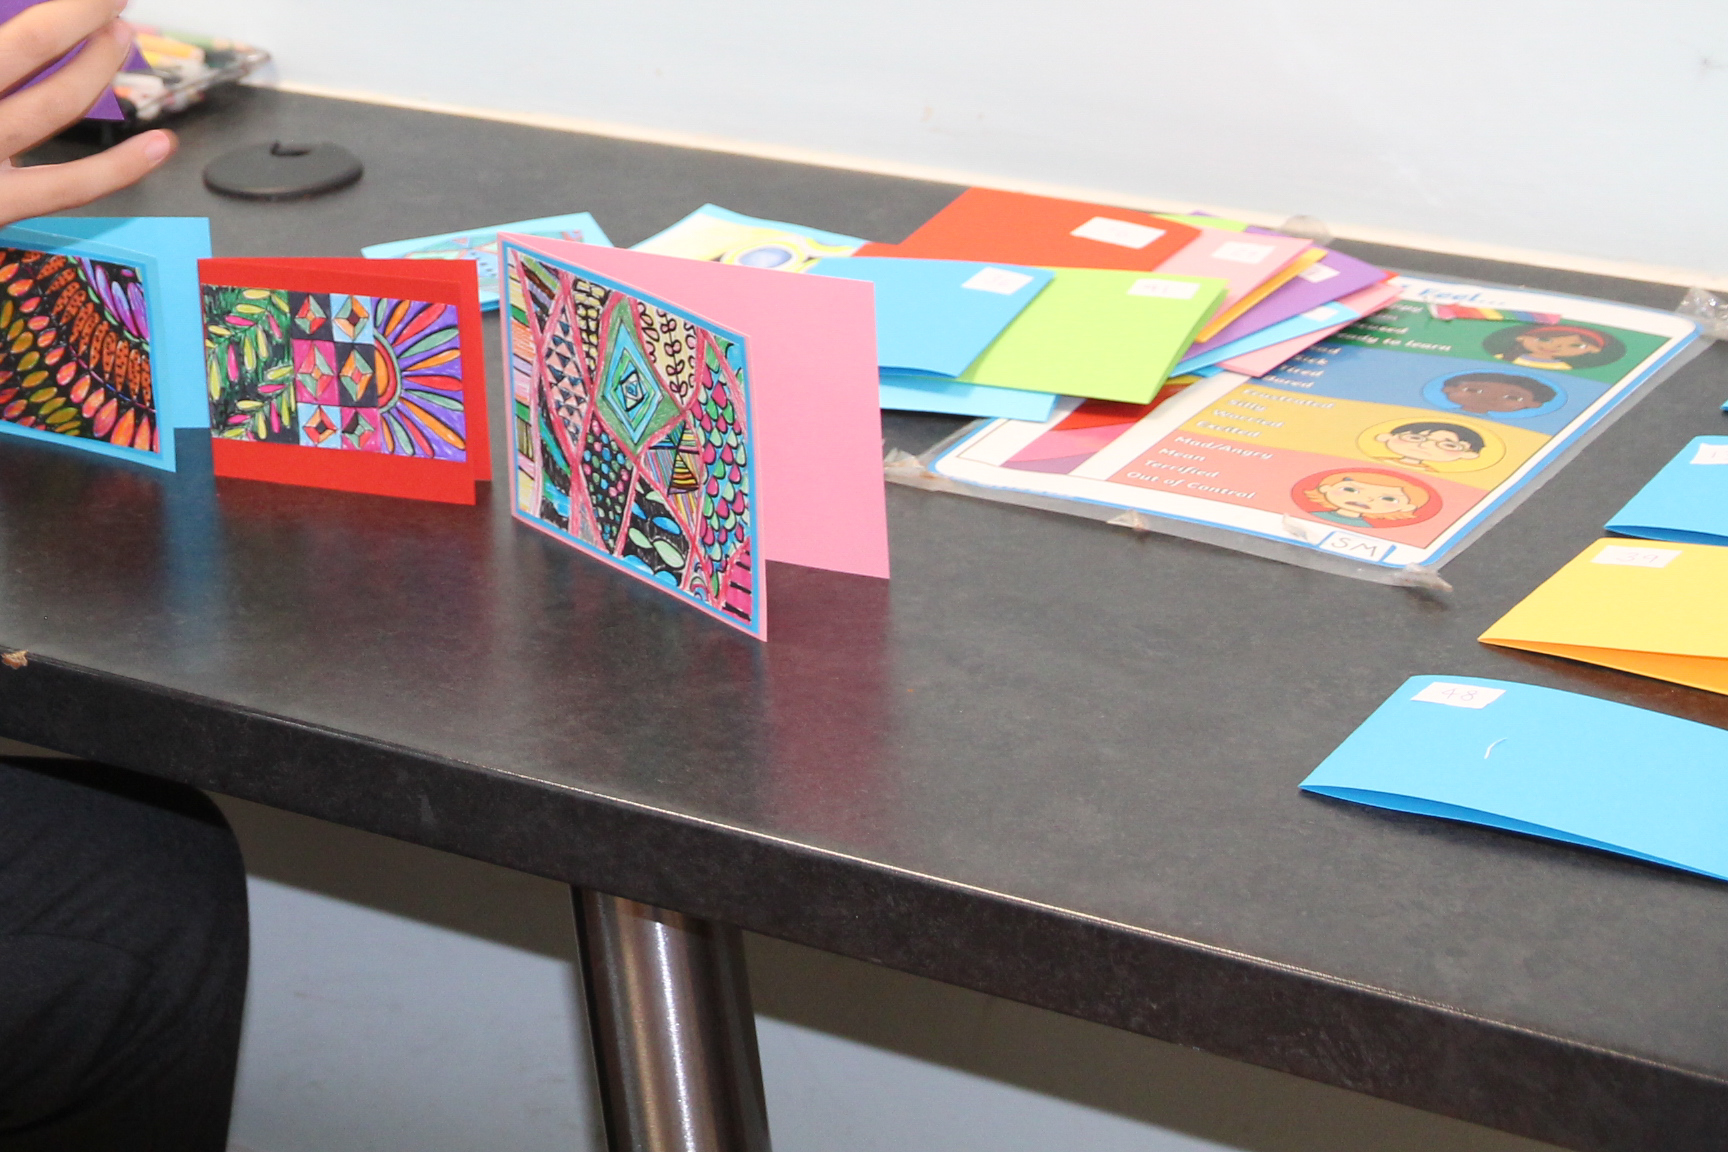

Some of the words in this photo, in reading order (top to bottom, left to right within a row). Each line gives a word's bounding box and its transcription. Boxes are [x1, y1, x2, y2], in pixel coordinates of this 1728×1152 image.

[1382, 337, 1402, 346] to
[1404, 339, 1452, 352] learn
[1227, 399, 1267, 412] Silly
[1243, 388, 1335, 409] Frustrated
[1212, 409, 1285, 428] Worried
[1196, 421, 1262, 438] Excited
[1158, 448, 1207, 462] Mean
[1174, 436, 1274, 460] Mad/Angry
[1144, 459, 1220, 478] Terrified
[1126, 471, 1161, 483] Out
[1163, 478, 1186, 487] of
[1186, 481, 1257, 499] Control
[1331, 537, 1378, 557] SM
[1441, 687, 1478, 702] 48
